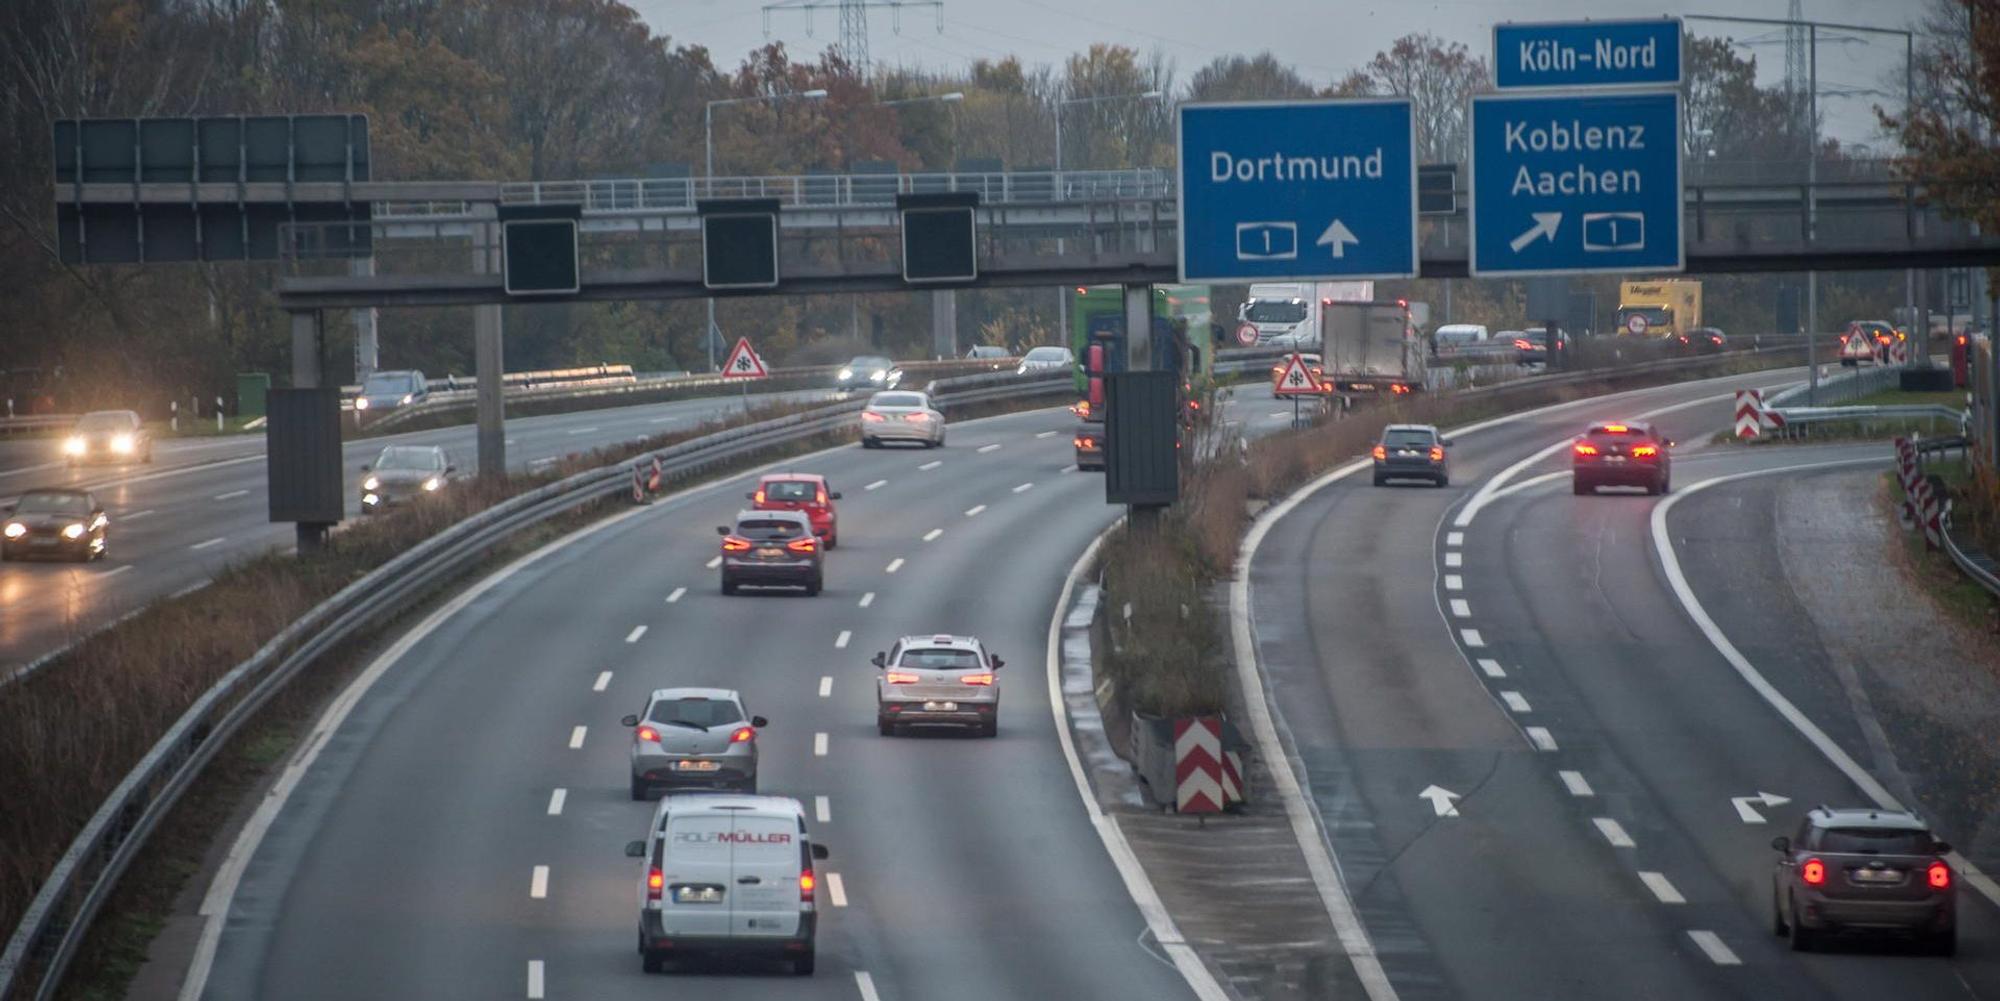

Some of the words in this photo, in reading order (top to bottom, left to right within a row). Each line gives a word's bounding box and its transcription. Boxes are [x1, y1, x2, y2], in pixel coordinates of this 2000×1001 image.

[1519, 36, 1656, 72] Köln-Nord
[1504, 119, 1645, 153] Koblenz
[1211, 147, 1383, 182] Dortmund
[1512, 163, 1641, 196] Aachen
[1263, 229, 1270, 253] 1
[1609, 220, 1617, 244] 1
